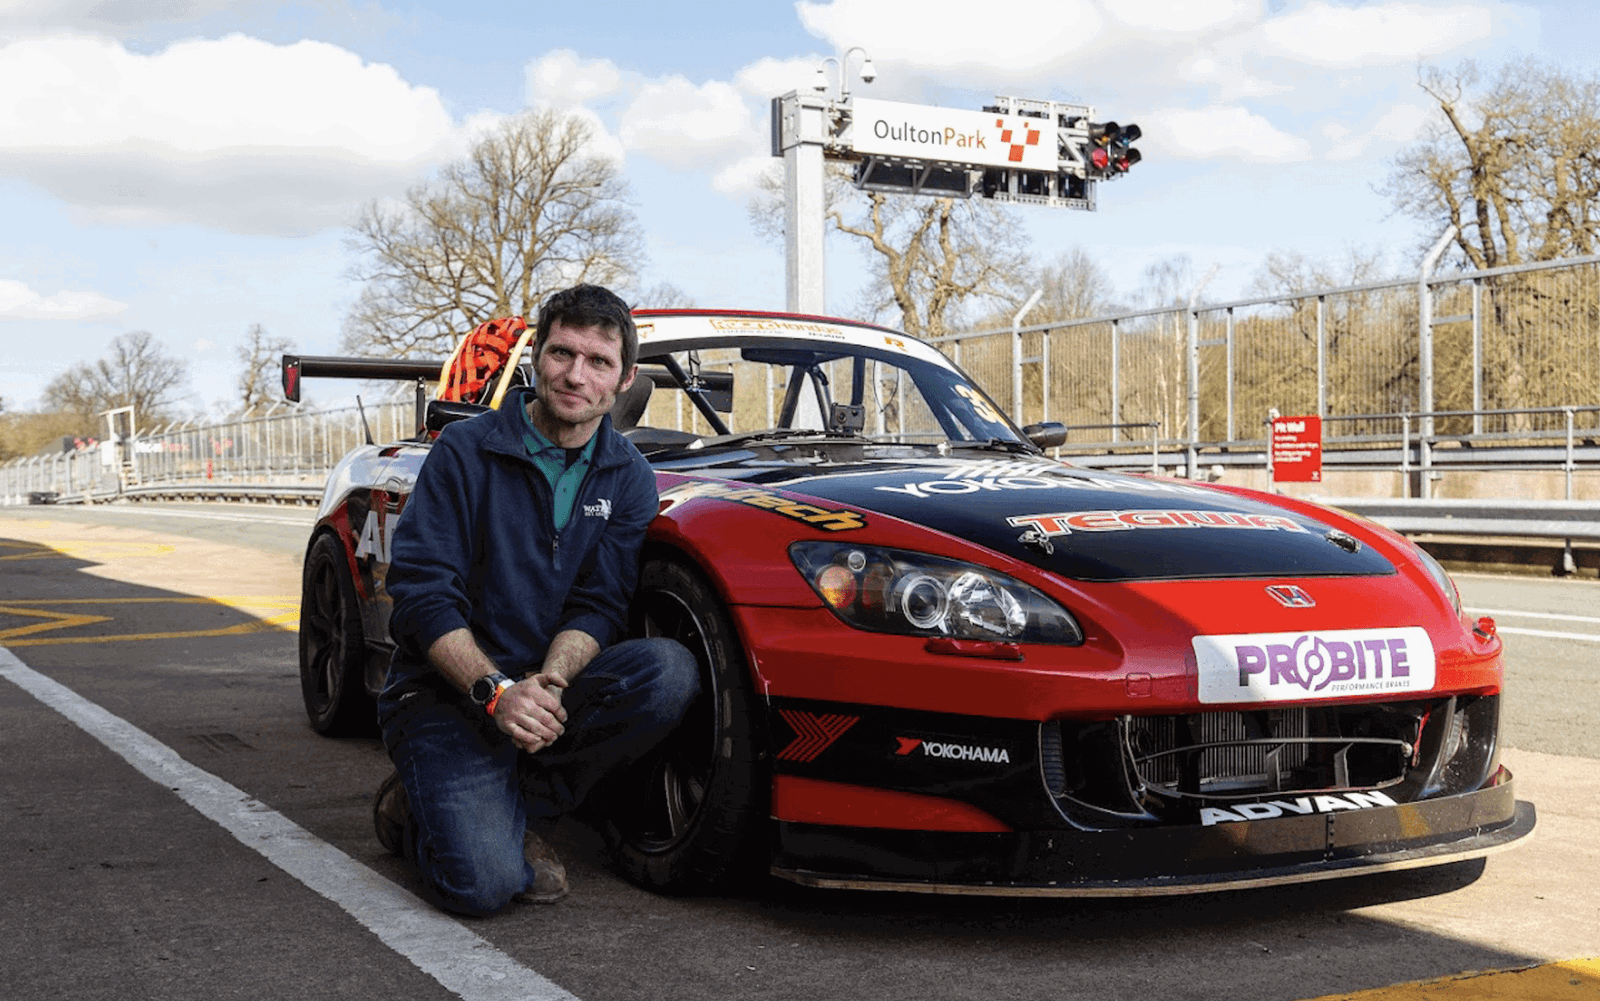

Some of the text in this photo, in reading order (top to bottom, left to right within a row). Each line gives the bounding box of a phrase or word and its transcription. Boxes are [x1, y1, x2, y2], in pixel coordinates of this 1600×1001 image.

[873, 119, 987, 150] OultonPark
[1235, 634, 1411, 692] PROBITE
[1331, 680, 1411, 692] PERFORMANCE BRAKES
[922, 741, 1010, 763] YOKOHAMA
[1200, 790, 1399, 827] ADVAN
